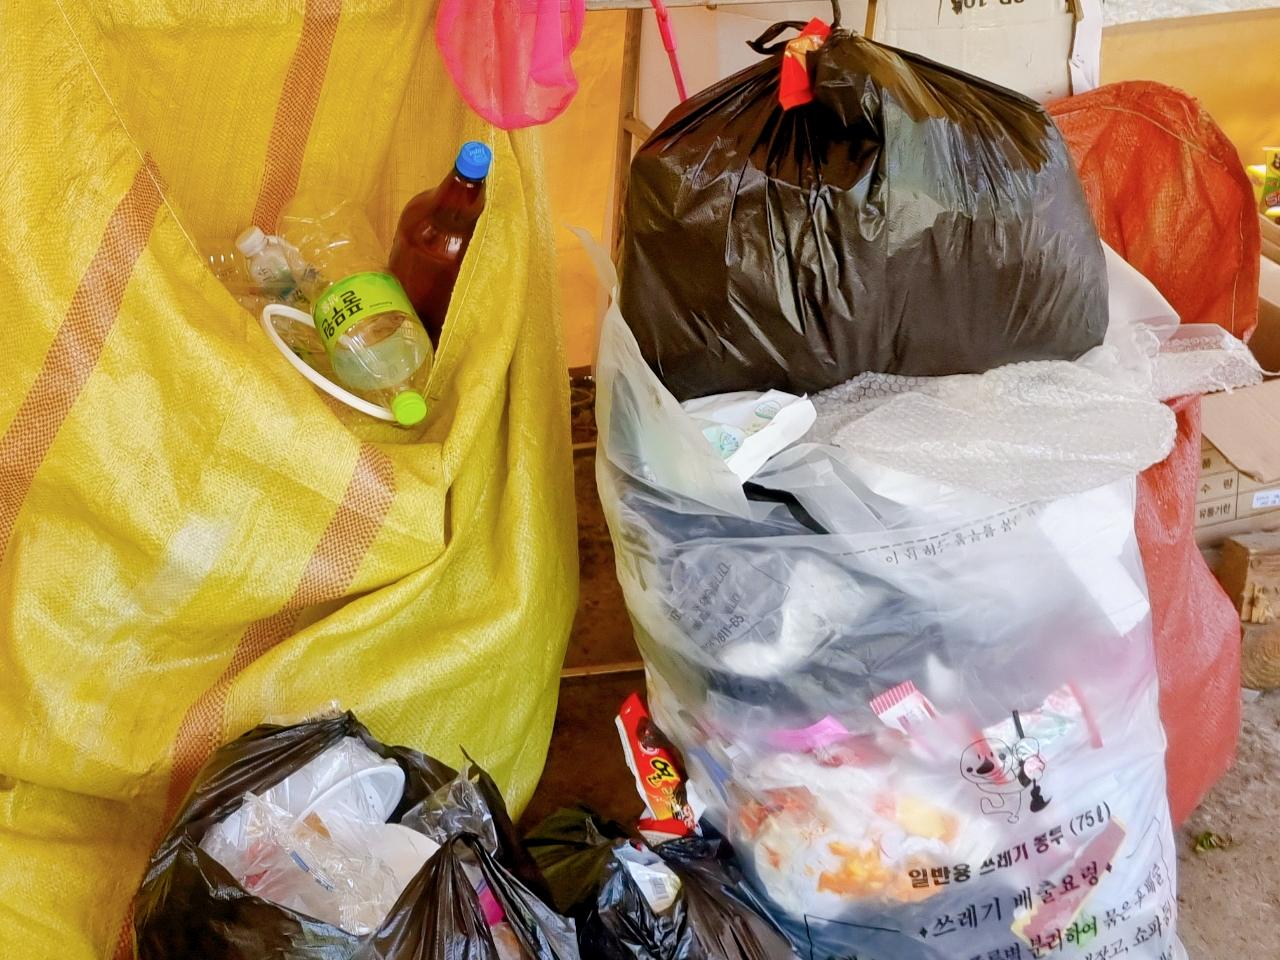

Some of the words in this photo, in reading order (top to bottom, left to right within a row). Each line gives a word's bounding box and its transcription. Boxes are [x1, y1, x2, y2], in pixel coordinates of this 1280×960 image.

[321, 290, 363, 340] 풀무원
[908, 863, 971, 889] 일반용
[980, 842, 1029, 876] 쓰레기
[932, 897, 1002, 937] 쓰레기
